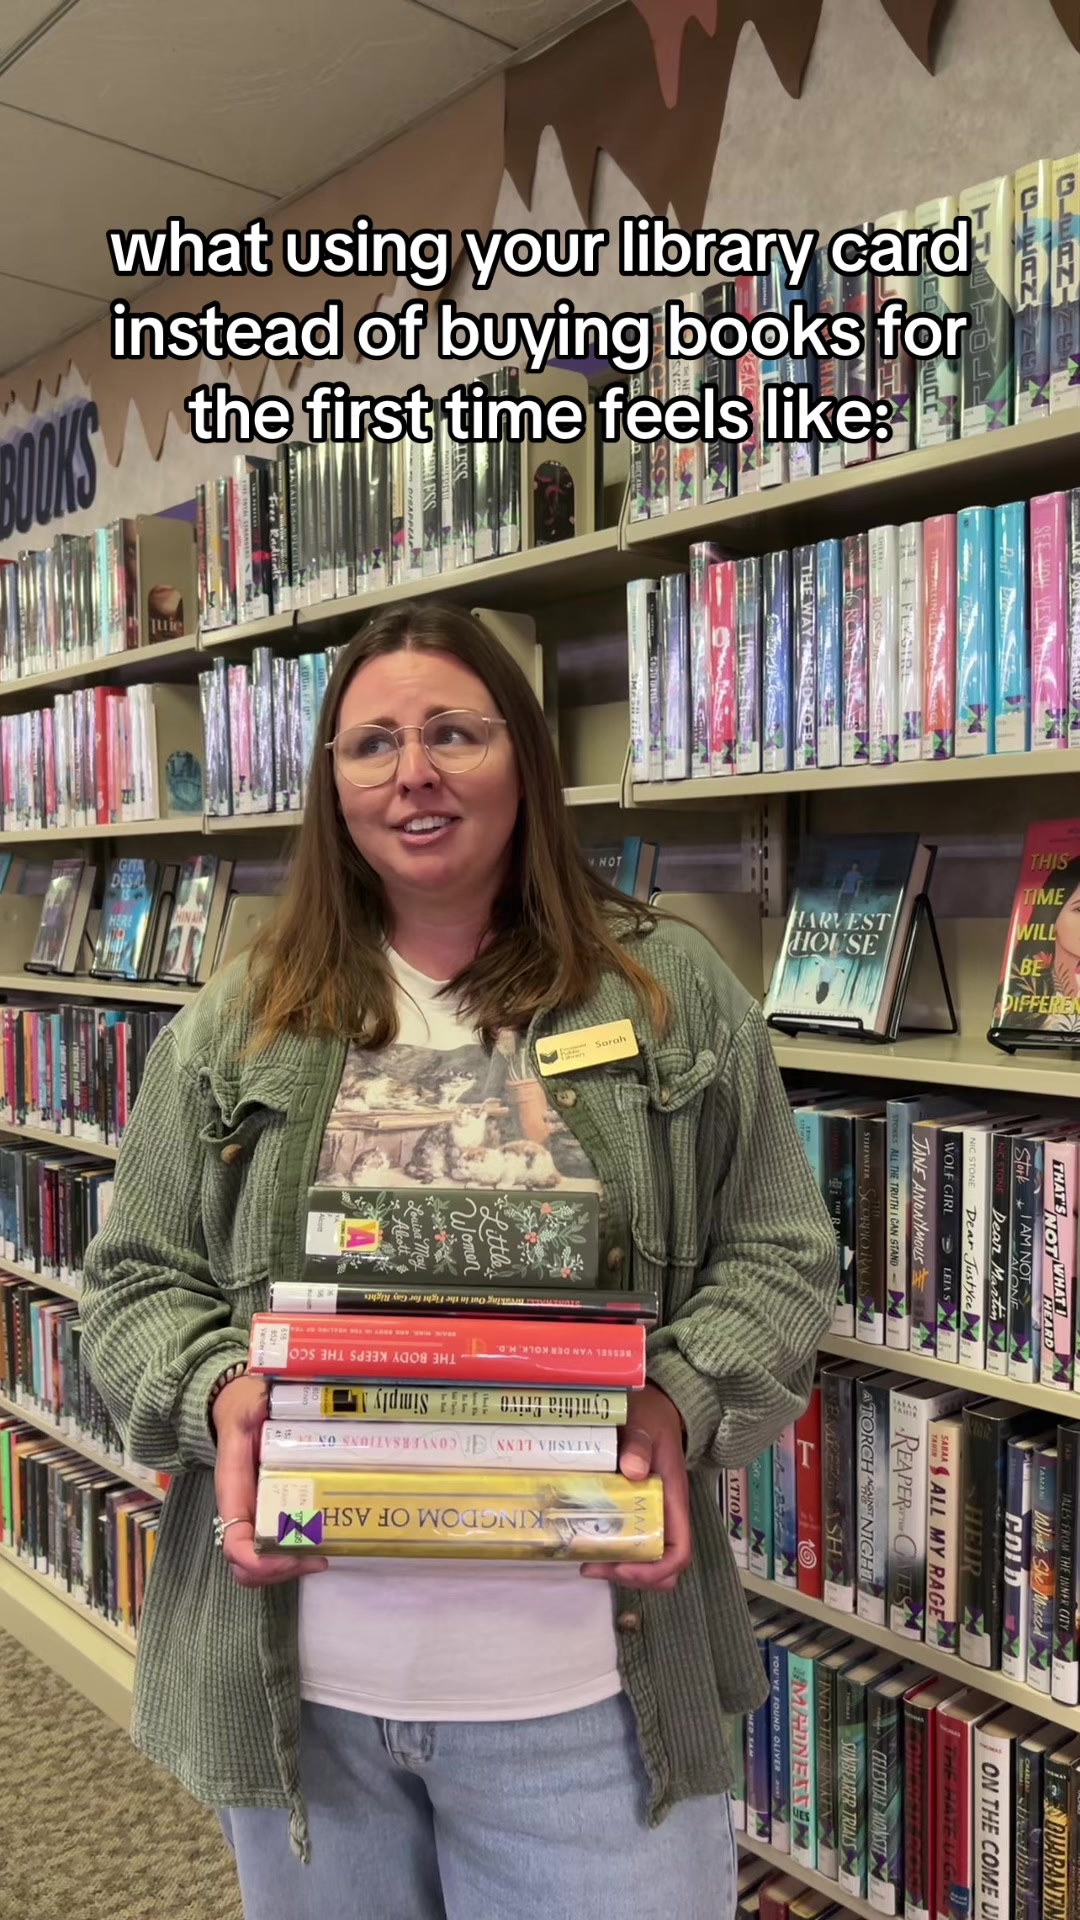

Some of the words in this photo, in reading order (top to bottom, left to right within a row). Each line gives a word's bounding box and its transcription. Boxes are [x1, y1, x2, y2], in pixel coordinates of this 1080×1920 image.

[970, 203, 992, 290] THE
[0, 401, 99, 541] BOOKS
[1034, 526, 1051, 552] SEE
[801, 564, 813, 595] THE
[1034, 560, 1051, 589] YOU
[929, 575, 937, 621] FALLING
[801, 602, 813, 637] WAY
[872, 596, 883, 661] BLOSSOM
[900, 603, 914, 684] FLYGIRL
[1034, 597, 1051, 683] YESTERDAY
[599, 855, 622, 868] NOT
[1031, 853, 1070, 870] THIS
[1024, 888, 1066, 906] TIME
[109, 915, 134, 927] HERE
[792, 911, 891, 932] HARVEST
[1016, 924, 1056, 941] WILL
[788, 930, 879, 958] HOUSE
[1020, 959, 1043, 977] BE
[1003, 994, 1080, 1015] DIFFEREN
[595, 1035, 627, 1048] Sarah
[889, 1148, 899, 1164] ALL
[911, 1134, 930, 1181] JANE
[968, 1137, 976, 1153] NIC
[996, 1142, 1004, 1158] NIC
[889, 1166, 899, 1181] THE
[943, 1141, 954, 1180] WOLF
[968, 1156, 976, 1188] STONE
[1013, 1147, 1031, 1184] Stork
[995, 1161, 1004, 1194] STONE
[1053, 1163, 1066, 1214] THAT'S
[889, 1182, 899, 1210] TRUTH
[943, 1184, 954, 1216] GIRL
[403, 1200, 429, 1240] Louisa
[857, 1186, 876, 1249] SCORPIO
[889, 1217, 899, 1236] CAN
[911, 1178, 930, 1264] ANONYMOUS
[965, 1206, 977, 1250] Dear
[991, 1208, 1006, 1254] Dear
[347, 1221, 376, 1248] YA
[390, 1215, 410, 1257] Alcott
[449, 1198, 484, 1276] Women
[478, 1206, 512, 1270] Little
[1020, 1223, 1031, 1246] AM
[1045, 1211, 1058, 1258] NOT
[405, 1239, 431, 1272] May
[889, 1239, 899, 1267] STAND
[943, 1267, 952, 1291] LEIA
[963, 1253, 979, 1310] Justyce
[1019, 1251, 1030, 1284] NOT
[989, 1260, 1006, 1321] Martin
[1010, 1255, 1019, 1310] ALONE
[1053, 1262, 1067, 1306] WHAT
[364, 1292, 389, 1303] Rights
[389, 1292, 406, 1303] Gay
[407, 1294, 419, 1304] for
[420, 1293, 444, 1305] Fight
[445, 1295, 459, 1305] the
[460, 1295, 469, 1305] in
[470, 1295, 486, 1305] Out
[488, 1294, 525, 1306] Breaking
[1043, 1297, 1054, 1349] HEARD
[289, 1347, 315, 1362] SCO
[318, 1348, 344, 1363] THE
[348, 1348, 388, 1364] KEEPS
[392, 1350, 428, 1365] BODY
[432, 1352, 457, 1365] THE
[495, 1344, 517, 1354] M.D.
[518, 1344, 549, 1355] KOLK,
[551, 1346, 571, 1356] DER
[572, 1347, 593, 1357] VAN
[595, 1348, 632, 1358] BESSEL
[374, 1389, 429, 1415] Simply
[500, 1395, 542, 1418] Erivo
[548, 1394, 610, 1420] Cynthia
[863, 1390, 871, 1402] A
[894, 1399, 918, 1411] SABAA
[894, 1406, 917, 1417] TAHIR
[318, 1435, 337, 1448] ON
[342, 1435, 457, 1451] CONVERSATIONS
[496, 1439, 533, 1452] LUNN
[538, 1440, 601, 1452] NATASHA
[861, 1403, 874, 1475] TORCH
[940, 1435, 949, 1462] SABAA
[891, 1432, 920, 1509] REAPER
[1038, 1466, 1046, 1501] TAMANI
[930, 1481, 946, 1516] ALL
[1061, 1492, 1072, 1520] TALES
[322, 1506, 373, 1528] ASH
[377, 1506, 412, 1529] OF
[418, 1506, 545, 1530] KINGDOM
[632, 1496, 648, 1548] MAAS
[1034, 1510, 1052, 1552] What
[860, 1516, 873, 1583] NIGHT
[930, 1526, 945, 1558] MY
[960, 1503, 982, 1576] HEIR
[1060, 1523, 1071, 1551] FROM
[893, 1534, 917, 1606] GATES
[1033, 1556, 1048, 1585] She
[1060, 1555, 1071, 1573] THE
[928, 1563, 945, 1620] RAGE
[1059, 1576, 1070, 1606] INNER
[1032, 1586, 1049, 1638] Missed
[1059, 1608, 1069, 1631] CITY
[819, 1680, 831, 1722] INTO
[792, 1680, 810, 1809] MADNESS
[940, 1724, 961, 1738] THOMAS
[944, 1745, 956, 1779] THE
[979, 1742, 1002, 1754] THOMAS
[840, 1740, 858, 1808] SUNBEARER
[871, 1749, 887, 1807] CELESTIAL
[982, 1762, 999, 1793] ON
[944, 1787, 957, 1838] HATE
[982, 1797, 999, 1835] THE
[841, 1810, 857, 1850] TRIALS
[944, 1842, 956, 1855] U
[981, 1840, 999, 1898] COME
